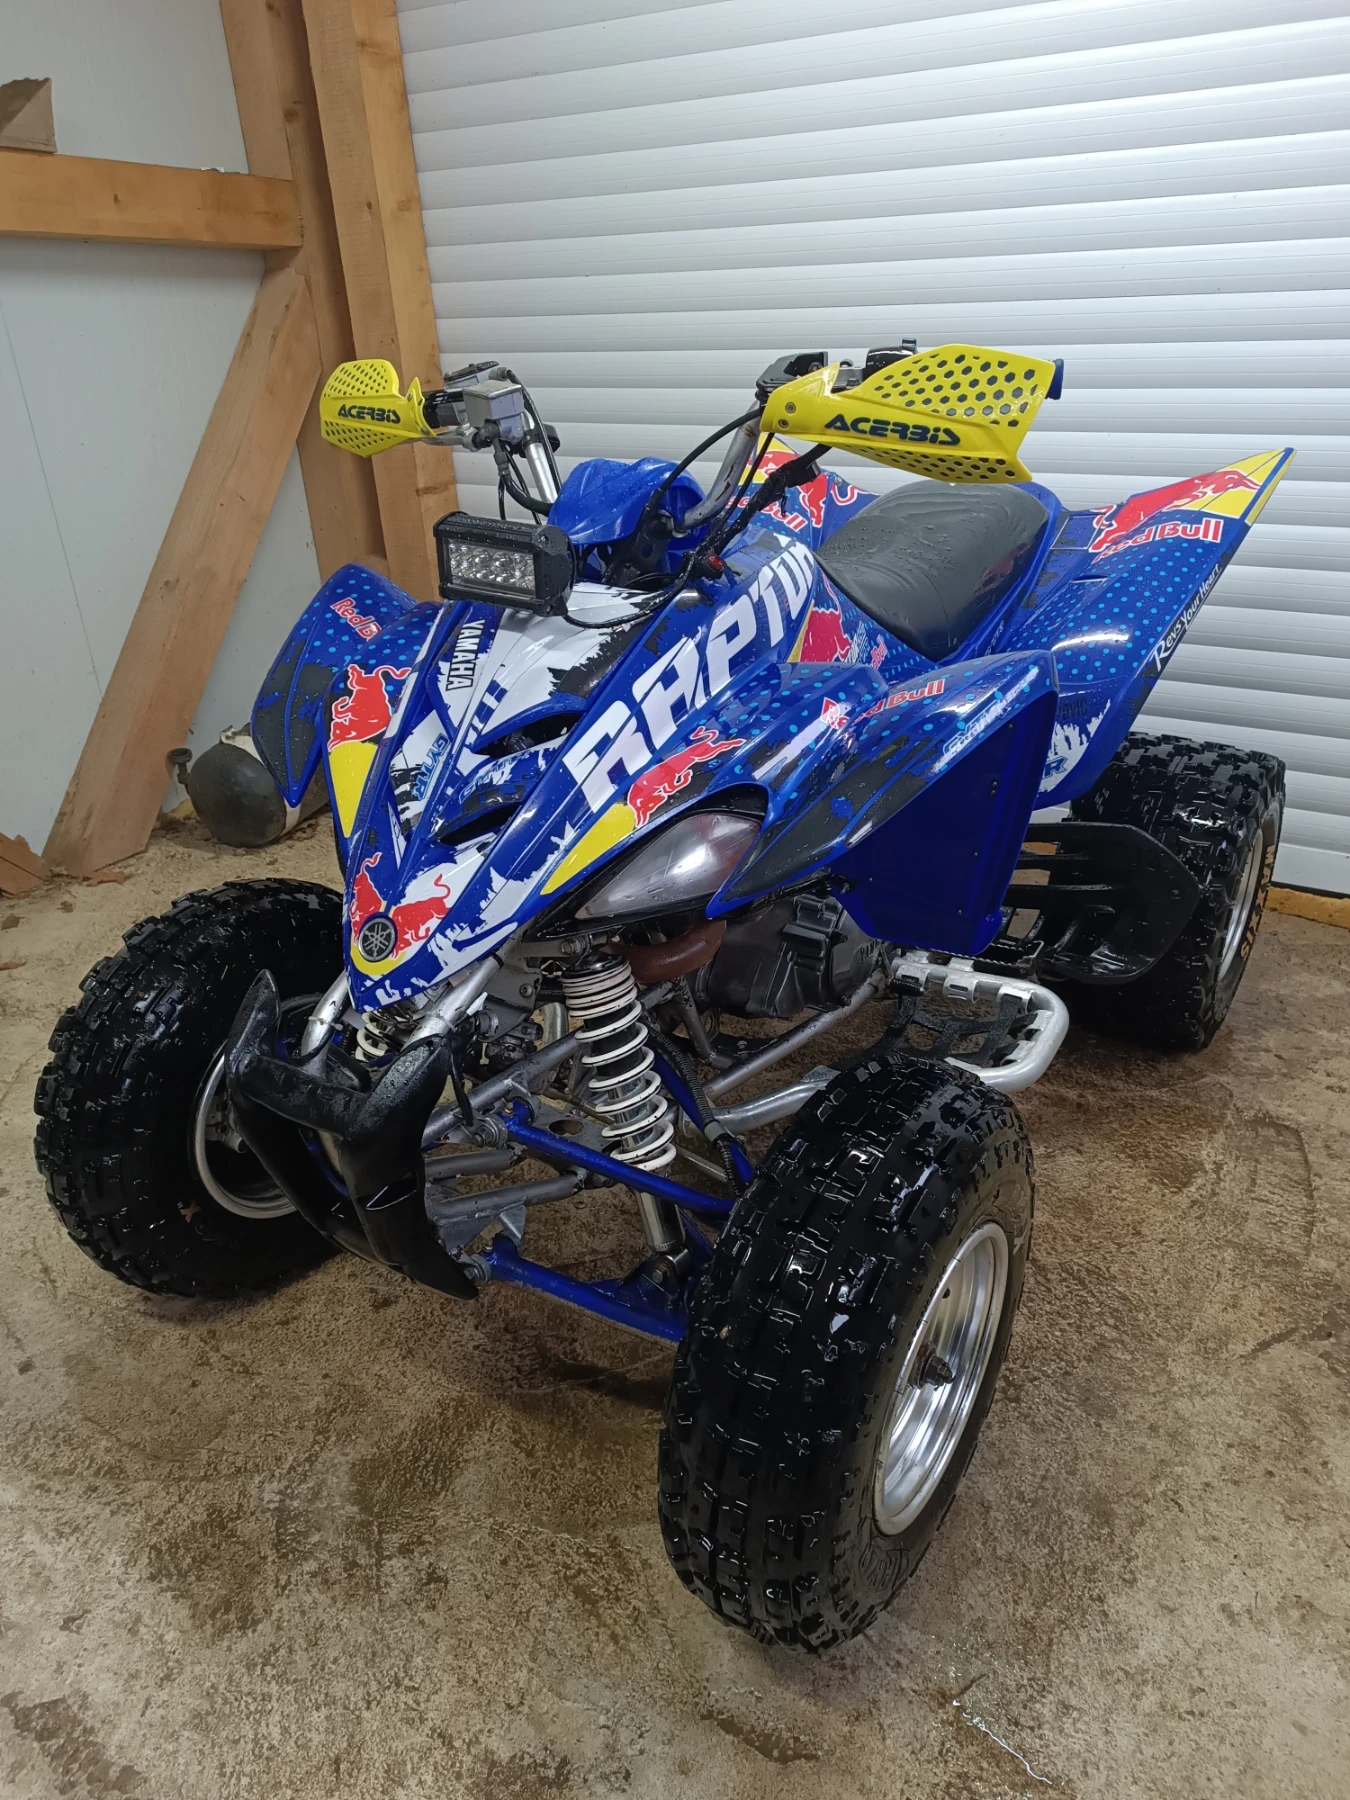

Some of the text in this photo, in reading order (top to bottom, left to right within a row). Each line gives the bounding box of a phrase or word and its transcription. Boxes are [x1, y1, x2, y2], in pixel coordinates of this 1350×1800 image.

[1155, 517, 1224, 544] Bull
[329, 596, 375, 628] Red
[1148, 563, 1220, 672] Revs Your Heart
[445, 619, 485, 691] YAMAHA
[886, 678, 945, 709] Bull
[411, 732, 451, 801] GYTR
